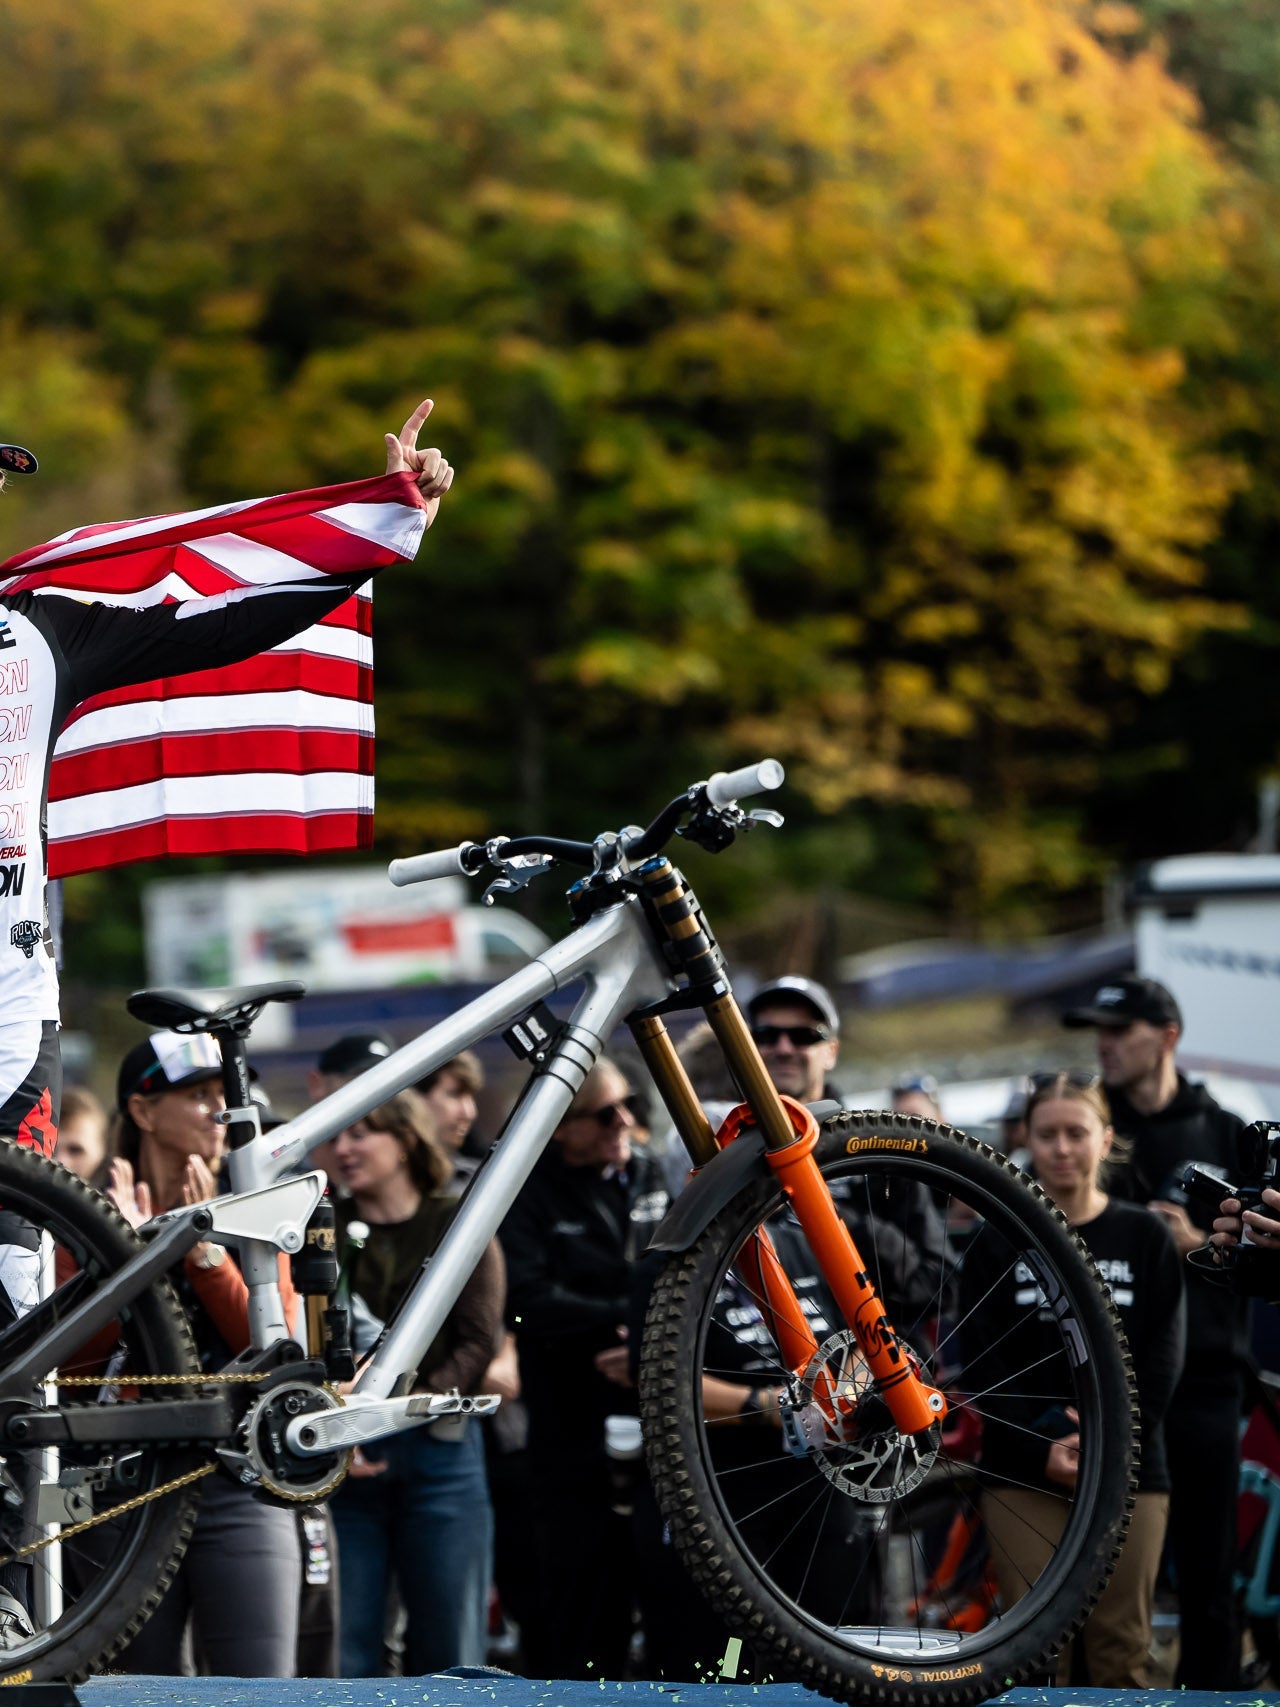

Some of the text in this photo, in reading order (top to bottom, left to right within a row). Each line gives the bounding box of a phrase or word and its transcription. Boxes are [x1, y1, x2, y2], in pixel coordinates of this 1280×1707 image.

[11, 920, 42, 944] ROCK
[846, 1135, 918, 1154] Continental
[920, 1662, 983, 1682] KRYPTOTAL
